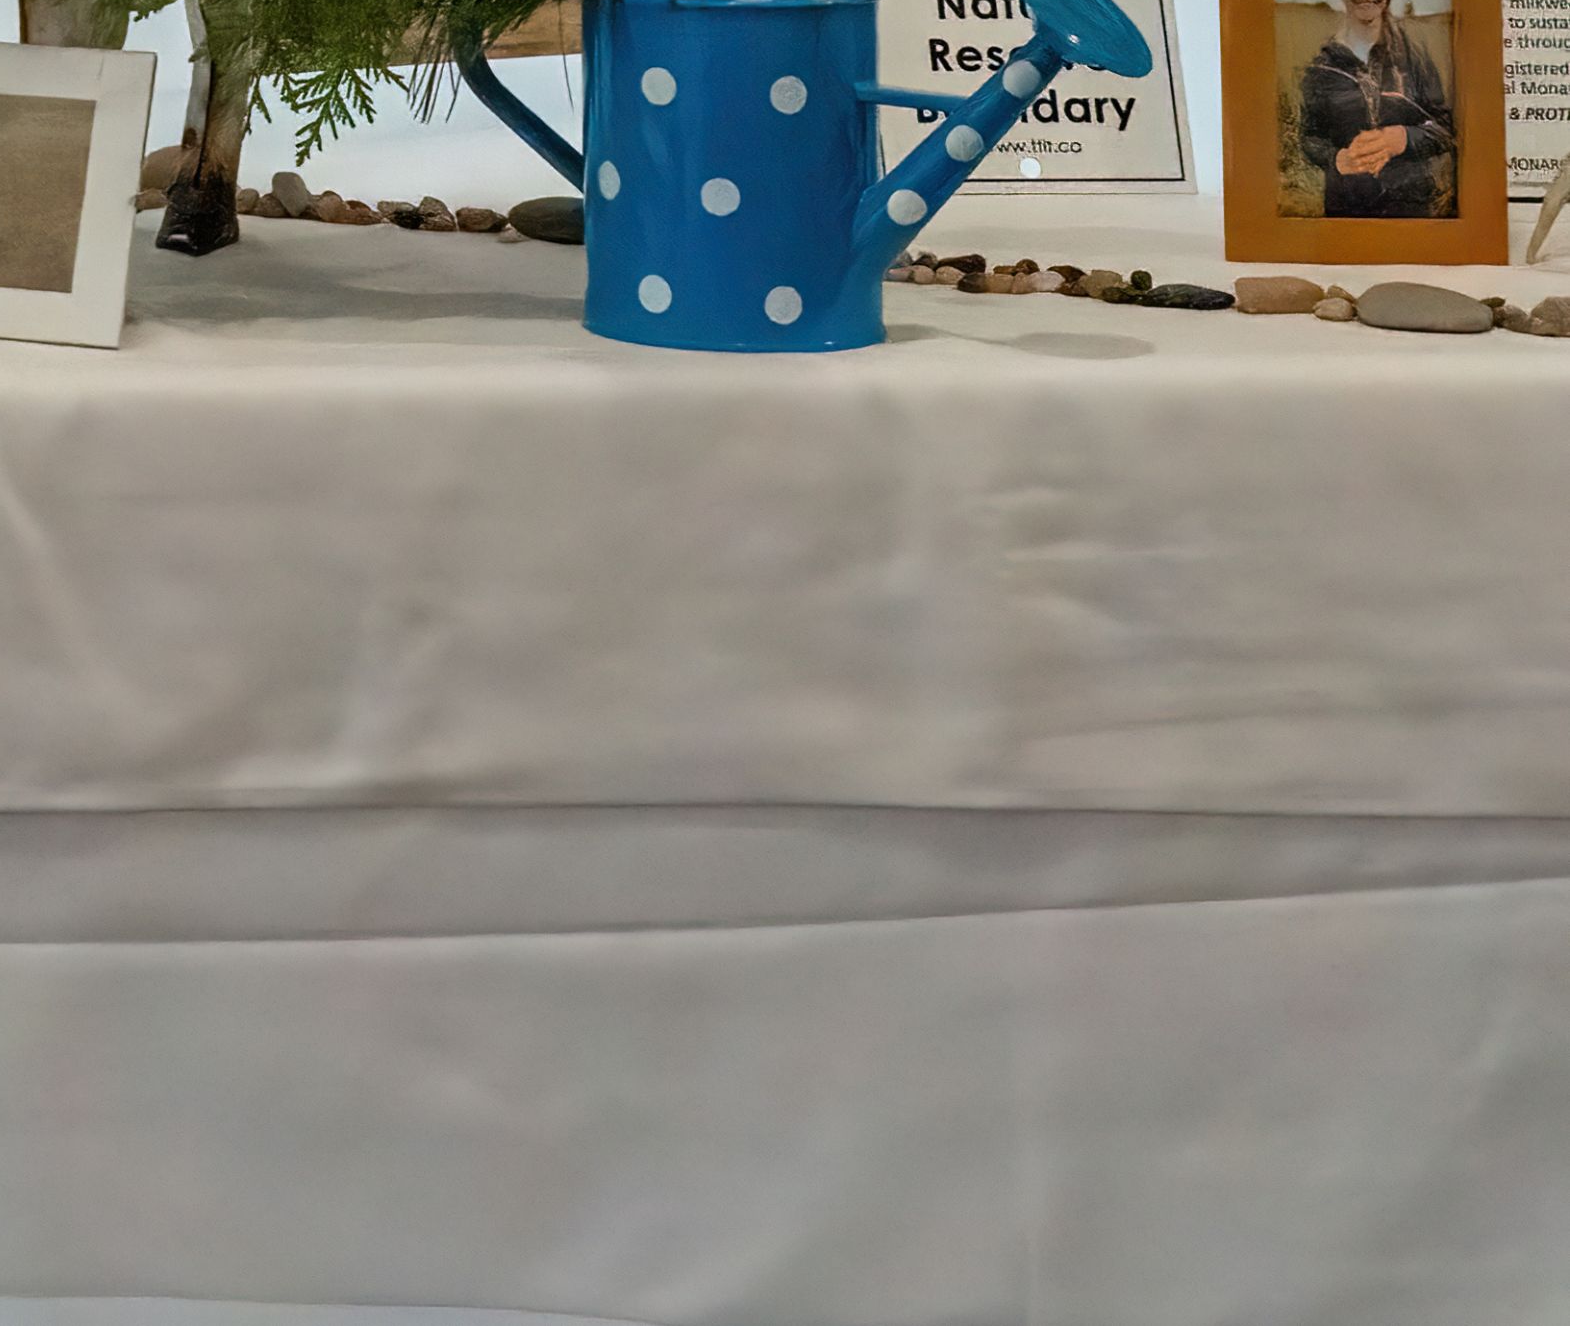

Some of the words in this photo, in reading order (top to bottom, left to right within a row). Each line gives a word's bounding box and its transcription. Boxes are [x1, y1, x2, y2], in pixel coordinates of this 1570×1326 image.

[1508, 17, 1525, 29] to
[1529, 17, 1570, 30] susta
[1509, 107, 1520, 121] &
